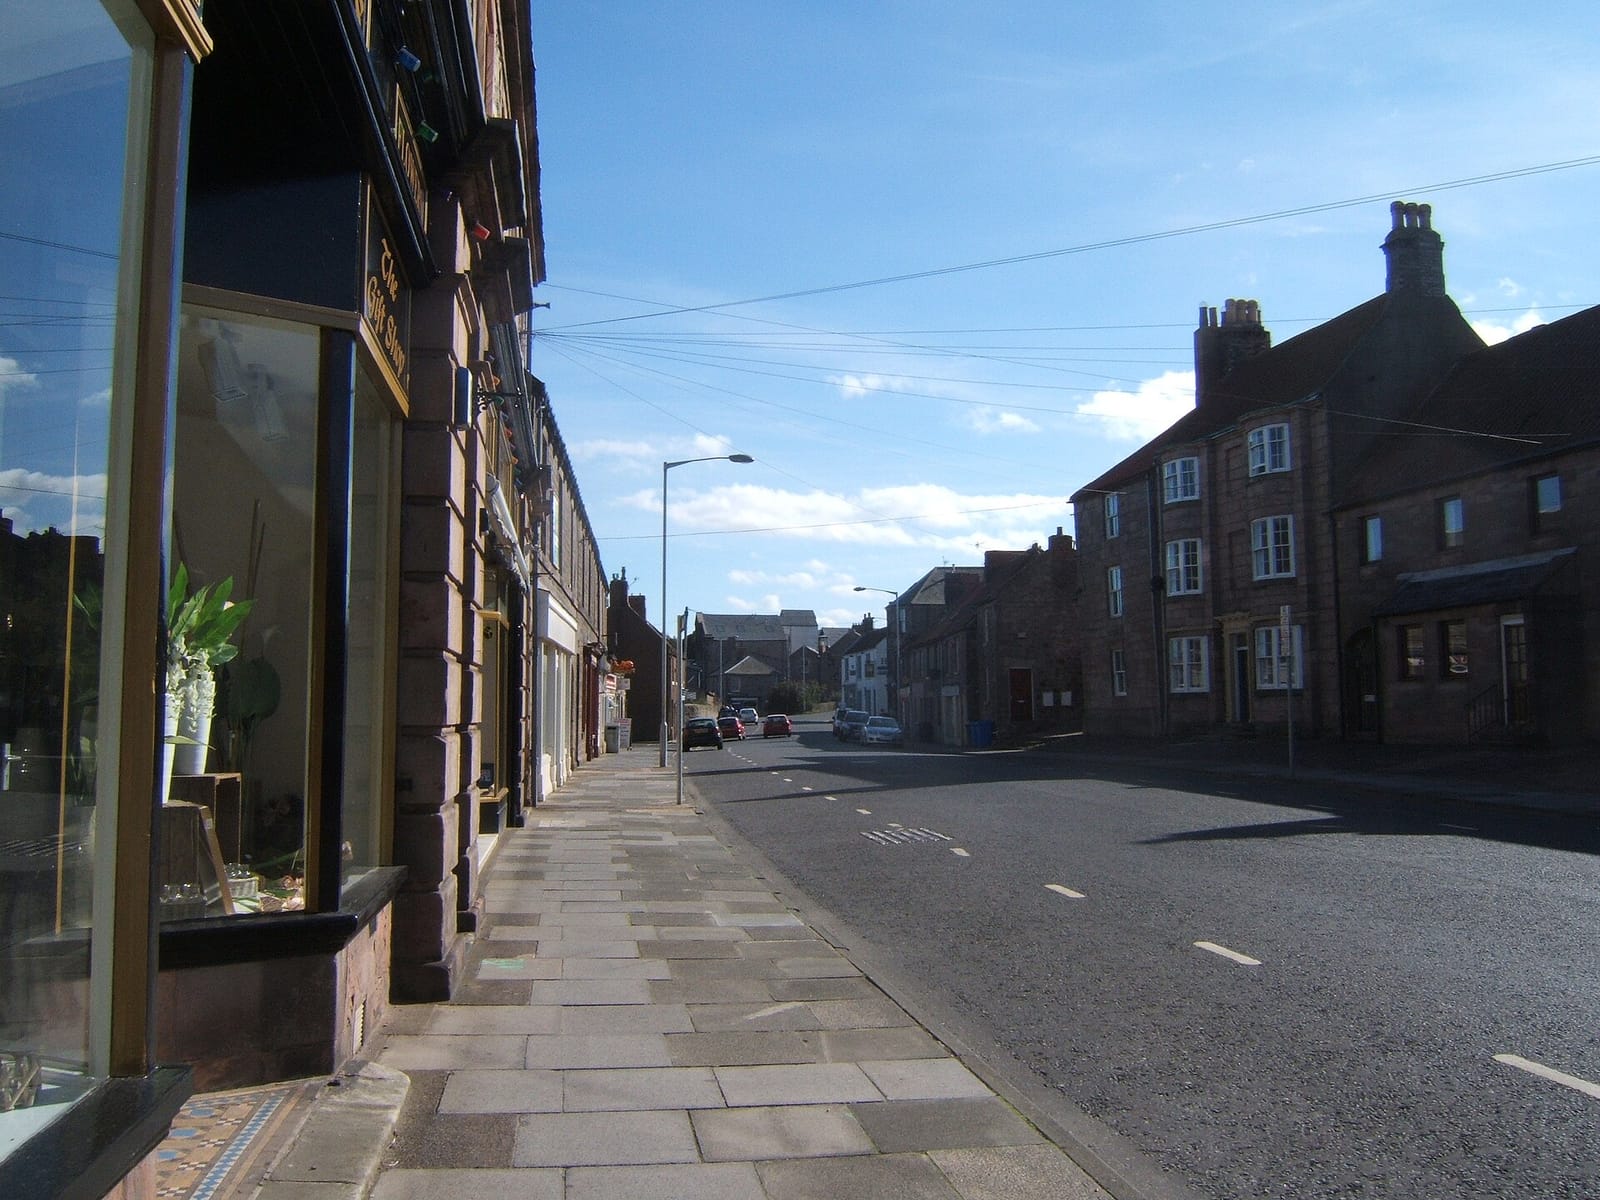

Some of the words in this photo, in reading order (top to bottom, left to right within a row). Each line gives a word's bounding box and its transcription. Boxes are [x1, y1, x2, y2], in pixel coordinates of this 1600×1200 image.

[381, 238, 398, 302] The
[367, 276, 386, 334] Gift
[385, 315, 405, 378] Shop
